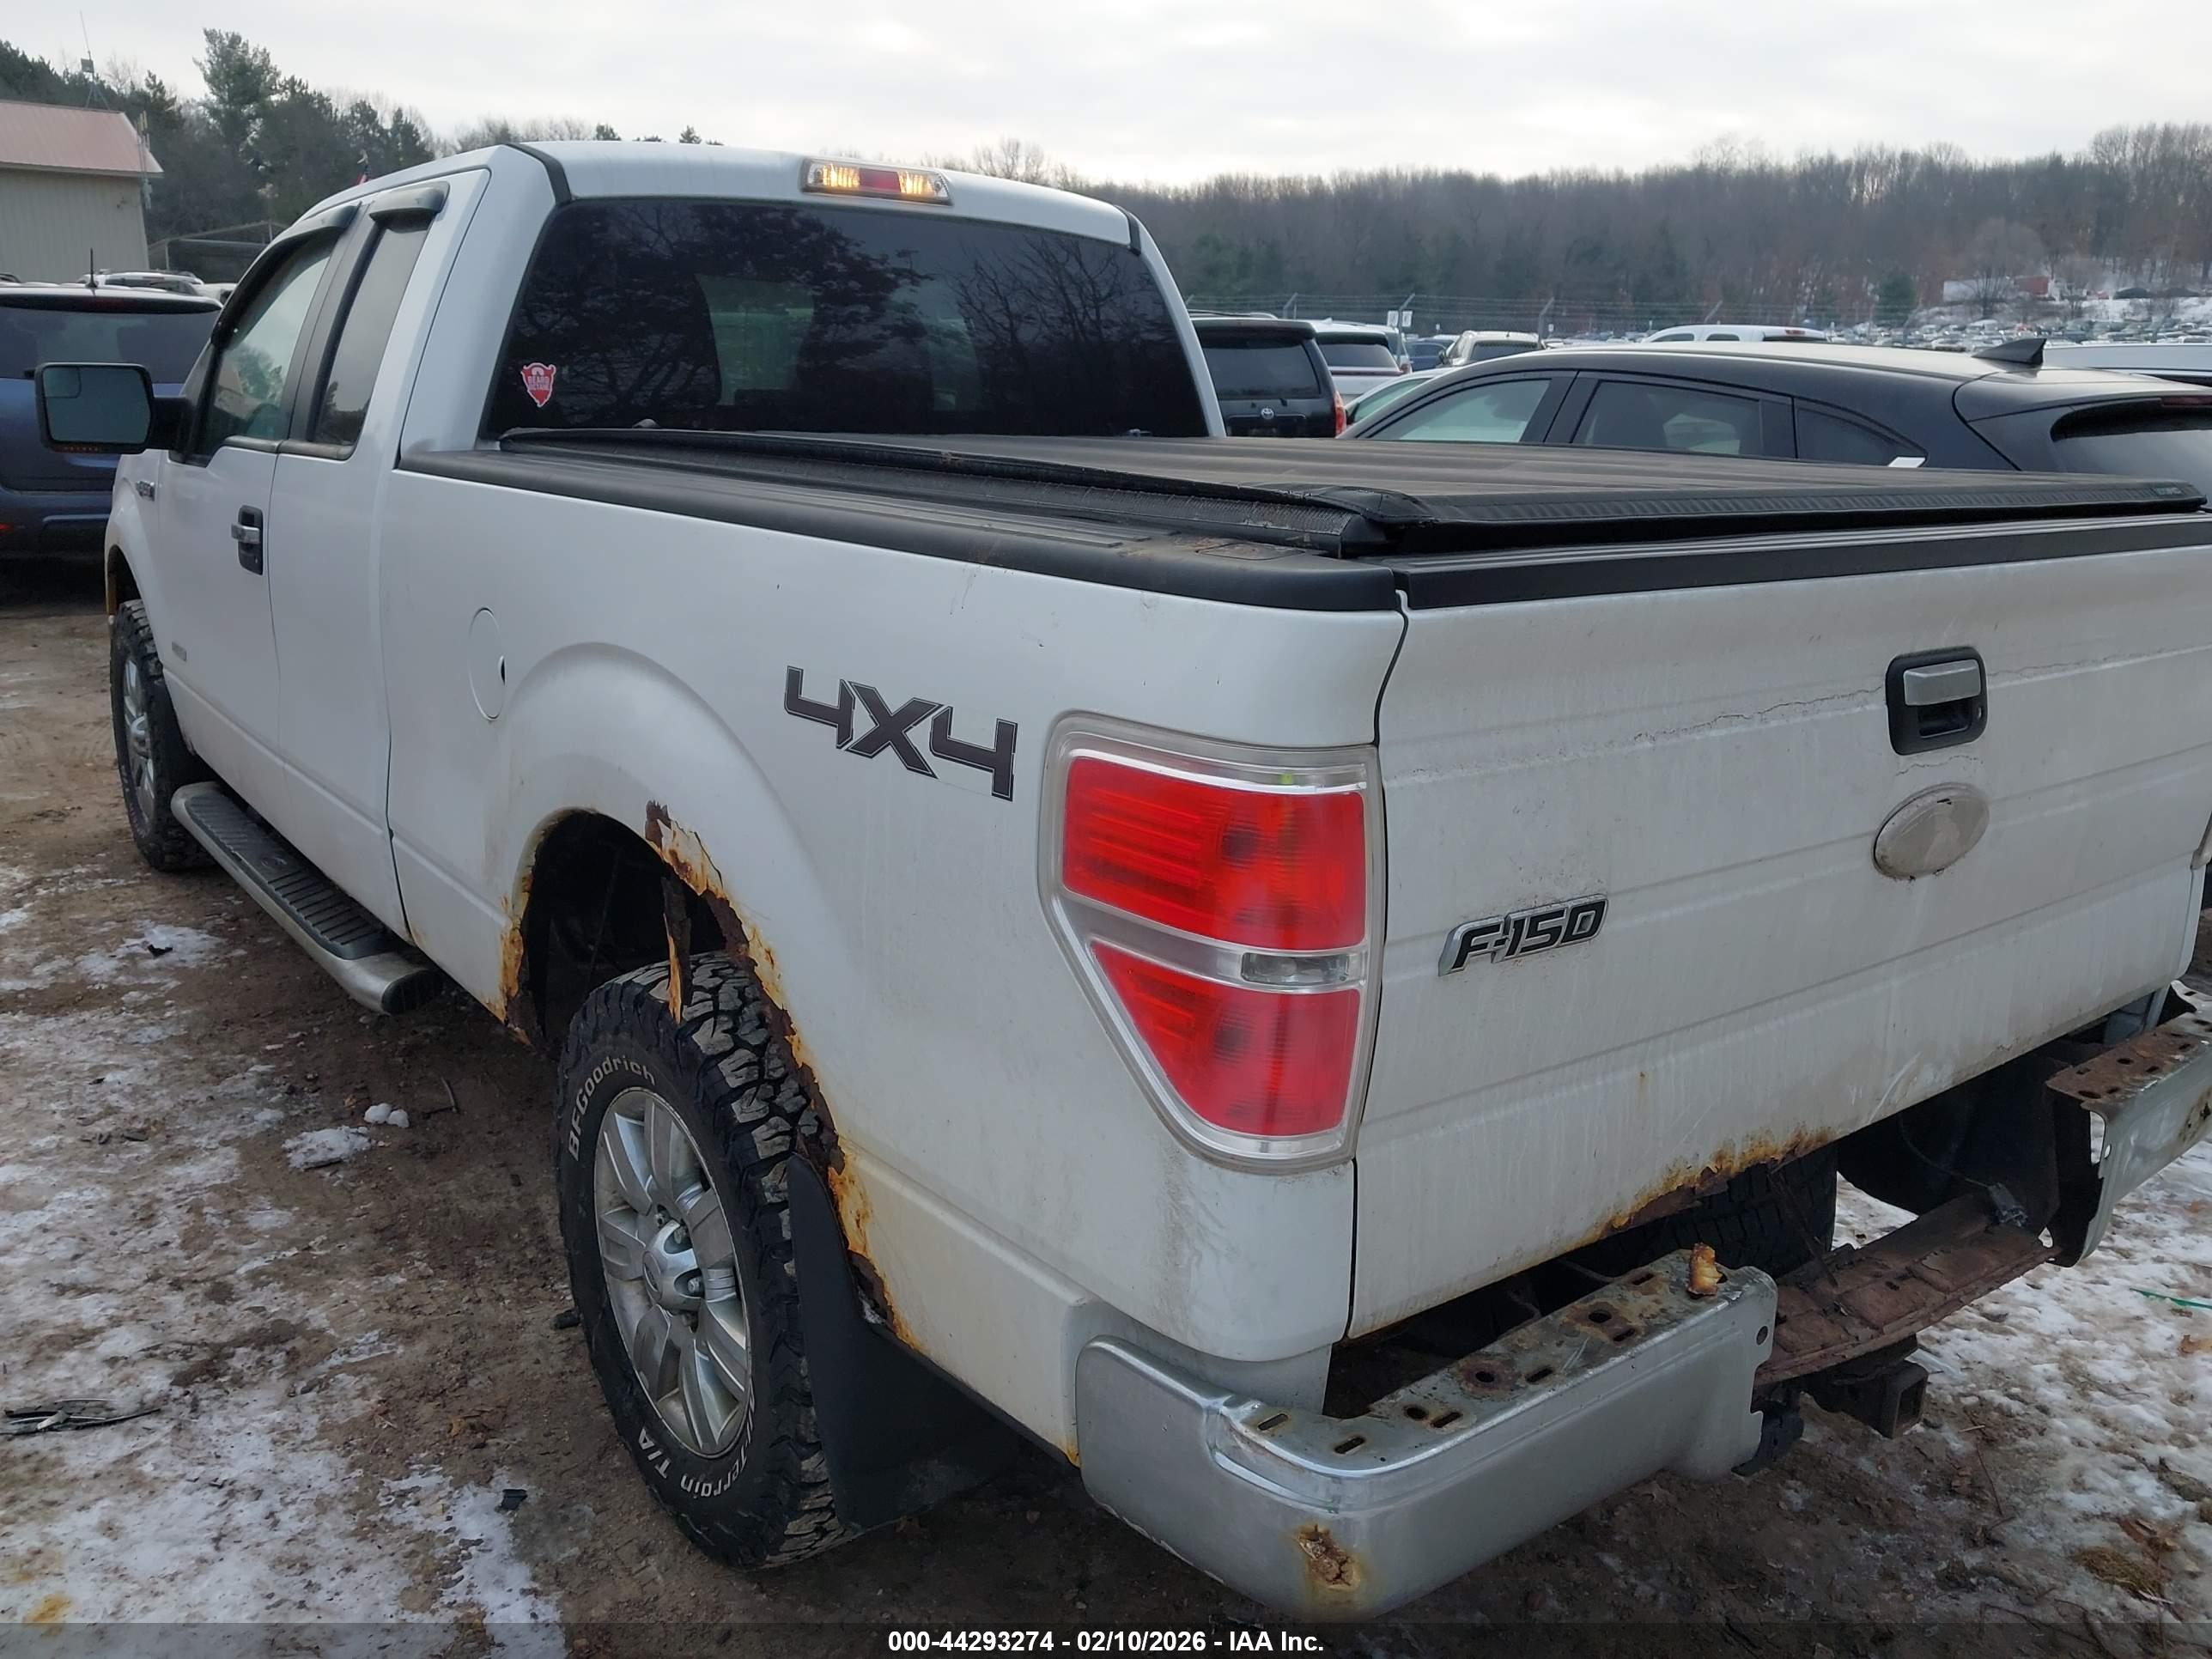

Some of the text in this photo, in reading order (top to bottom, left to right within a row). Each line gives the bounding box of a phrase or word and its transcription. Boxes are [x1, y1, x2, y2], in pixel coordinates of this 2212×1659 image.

[1438, 893, 1608, 976] F-150
[568, 1054, 655, 1161] BFGoodrich
[638, 1427, 672, 1480] T/A
